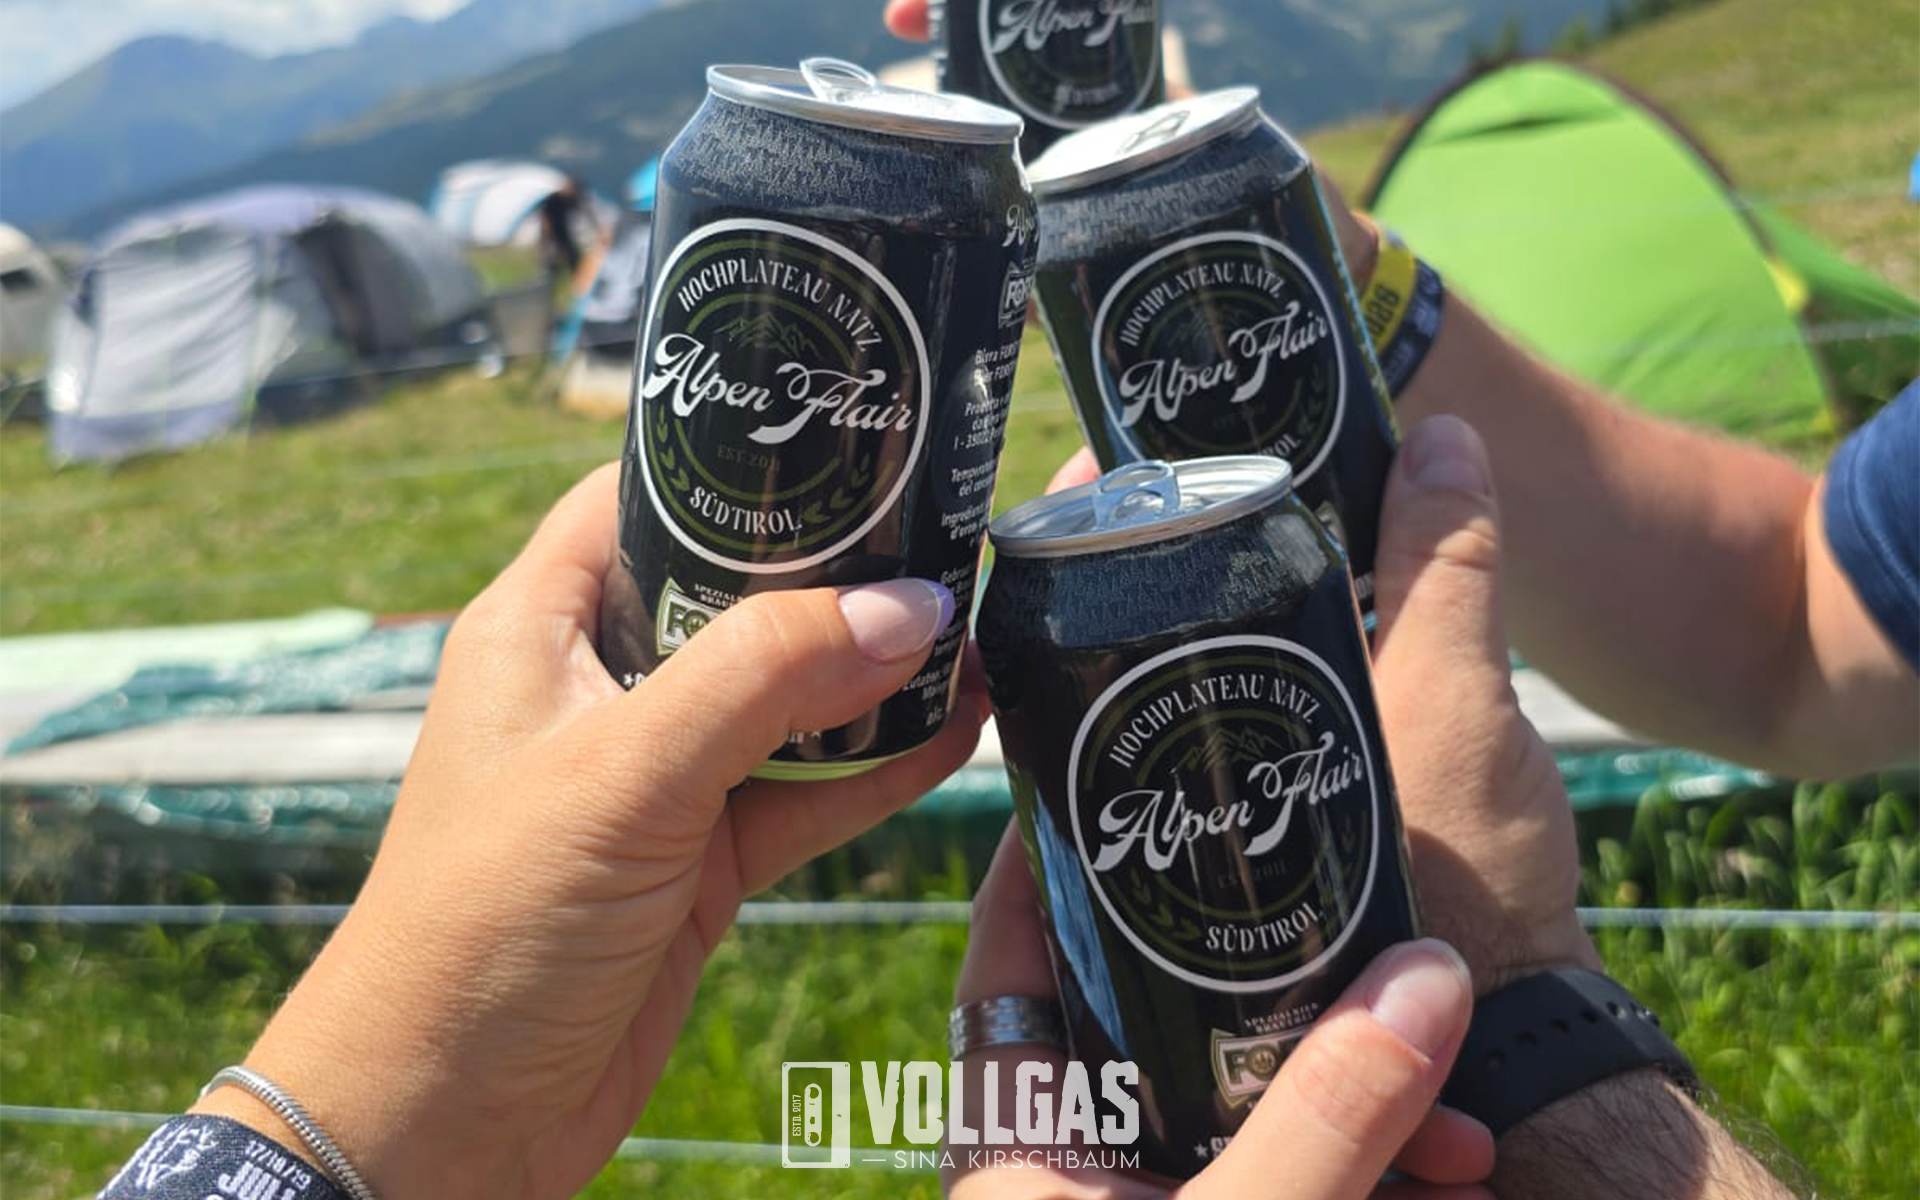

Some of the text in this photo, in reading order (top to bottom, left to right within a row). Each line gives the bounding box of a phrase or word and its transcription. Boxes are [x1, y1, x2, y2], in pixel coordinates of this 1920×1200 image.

[677, 258, 885, 352] HOCHPLATEAU NATZ
[1119, 262, 1286, 347] HOCHPLATEAU NATZ
[641, 333, 918, 445] Alpen Flair
[1119, 358, 1238, 428] Alpen
[1228, 300, 1329, 403] Flair
[689, 486, 804, 535] SÜDTIROL
[1109, 674, 1323, 769] HOCHPLATEAU NATZ
[1092, 731, 1364, 872] Alpen Flair
[1205, 901, 1325, 953] SÜDTIROL
